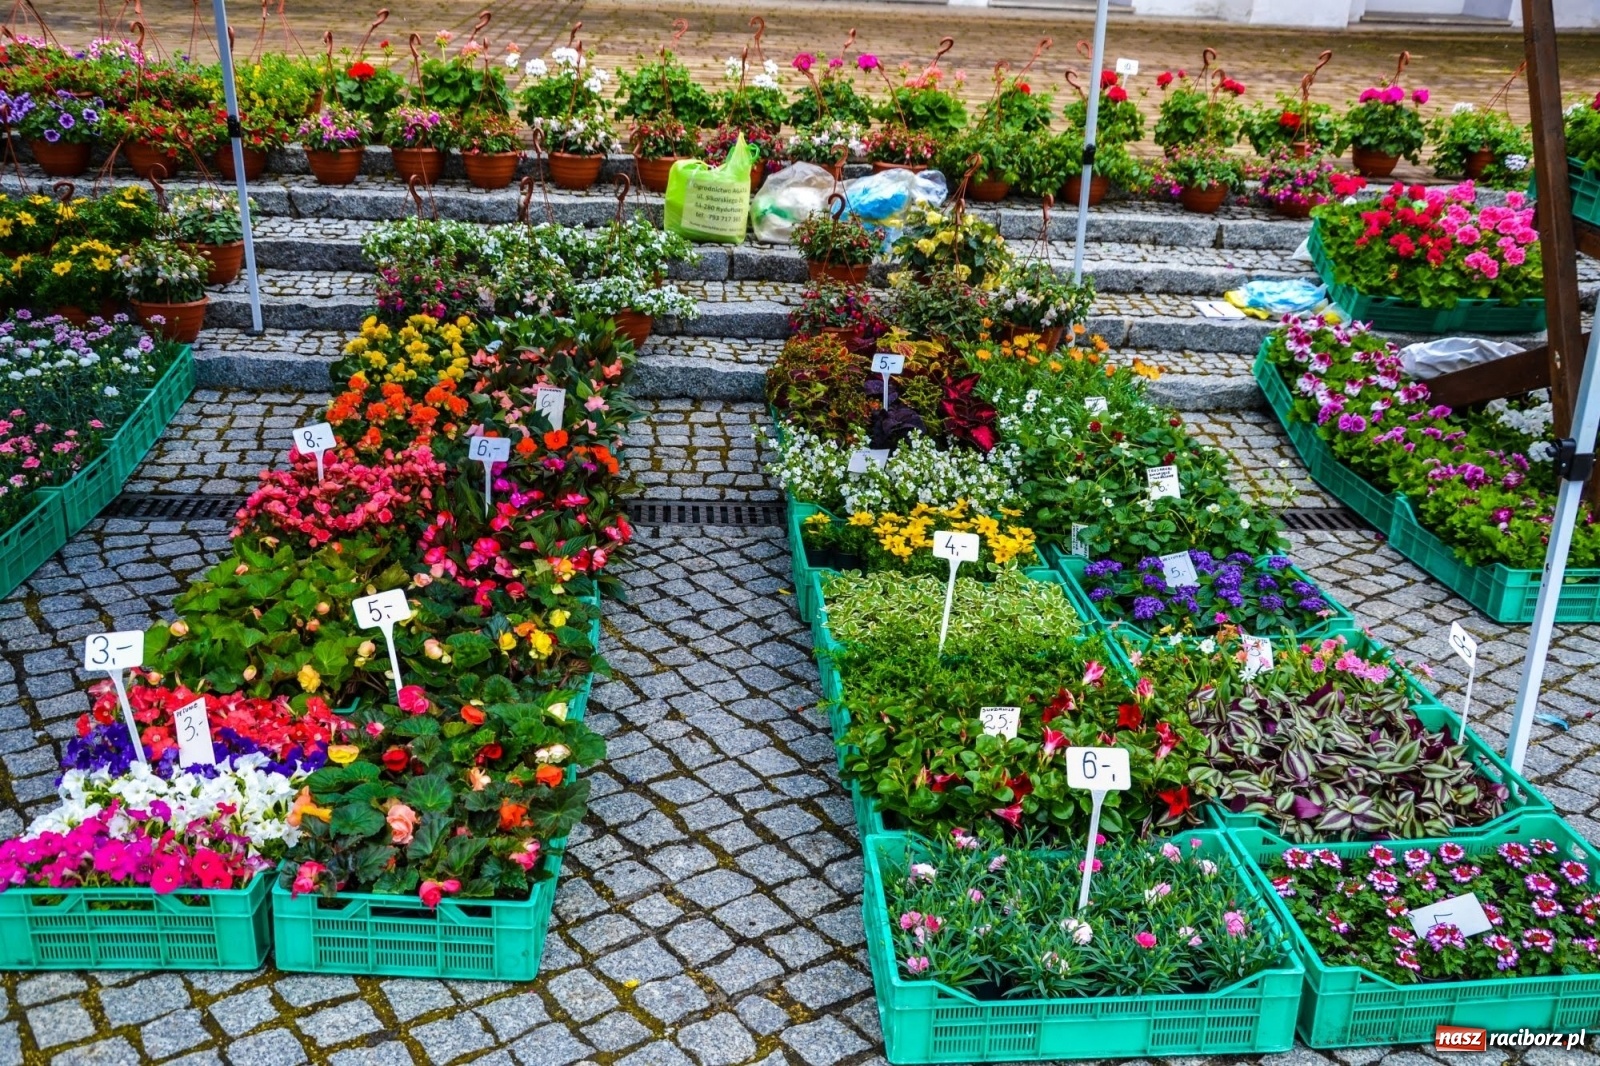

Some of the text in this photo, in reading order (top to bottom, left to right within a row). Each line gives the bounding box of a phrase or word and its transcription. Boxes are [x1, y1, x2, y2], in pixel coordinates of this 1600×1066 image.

[693, 183, 731, 194] Ogrodnictwo
[477, 439, 500, 457] 6,-
[945, 535, 967, 556] 4,-
[92, 635, 133, 665] 3,-
